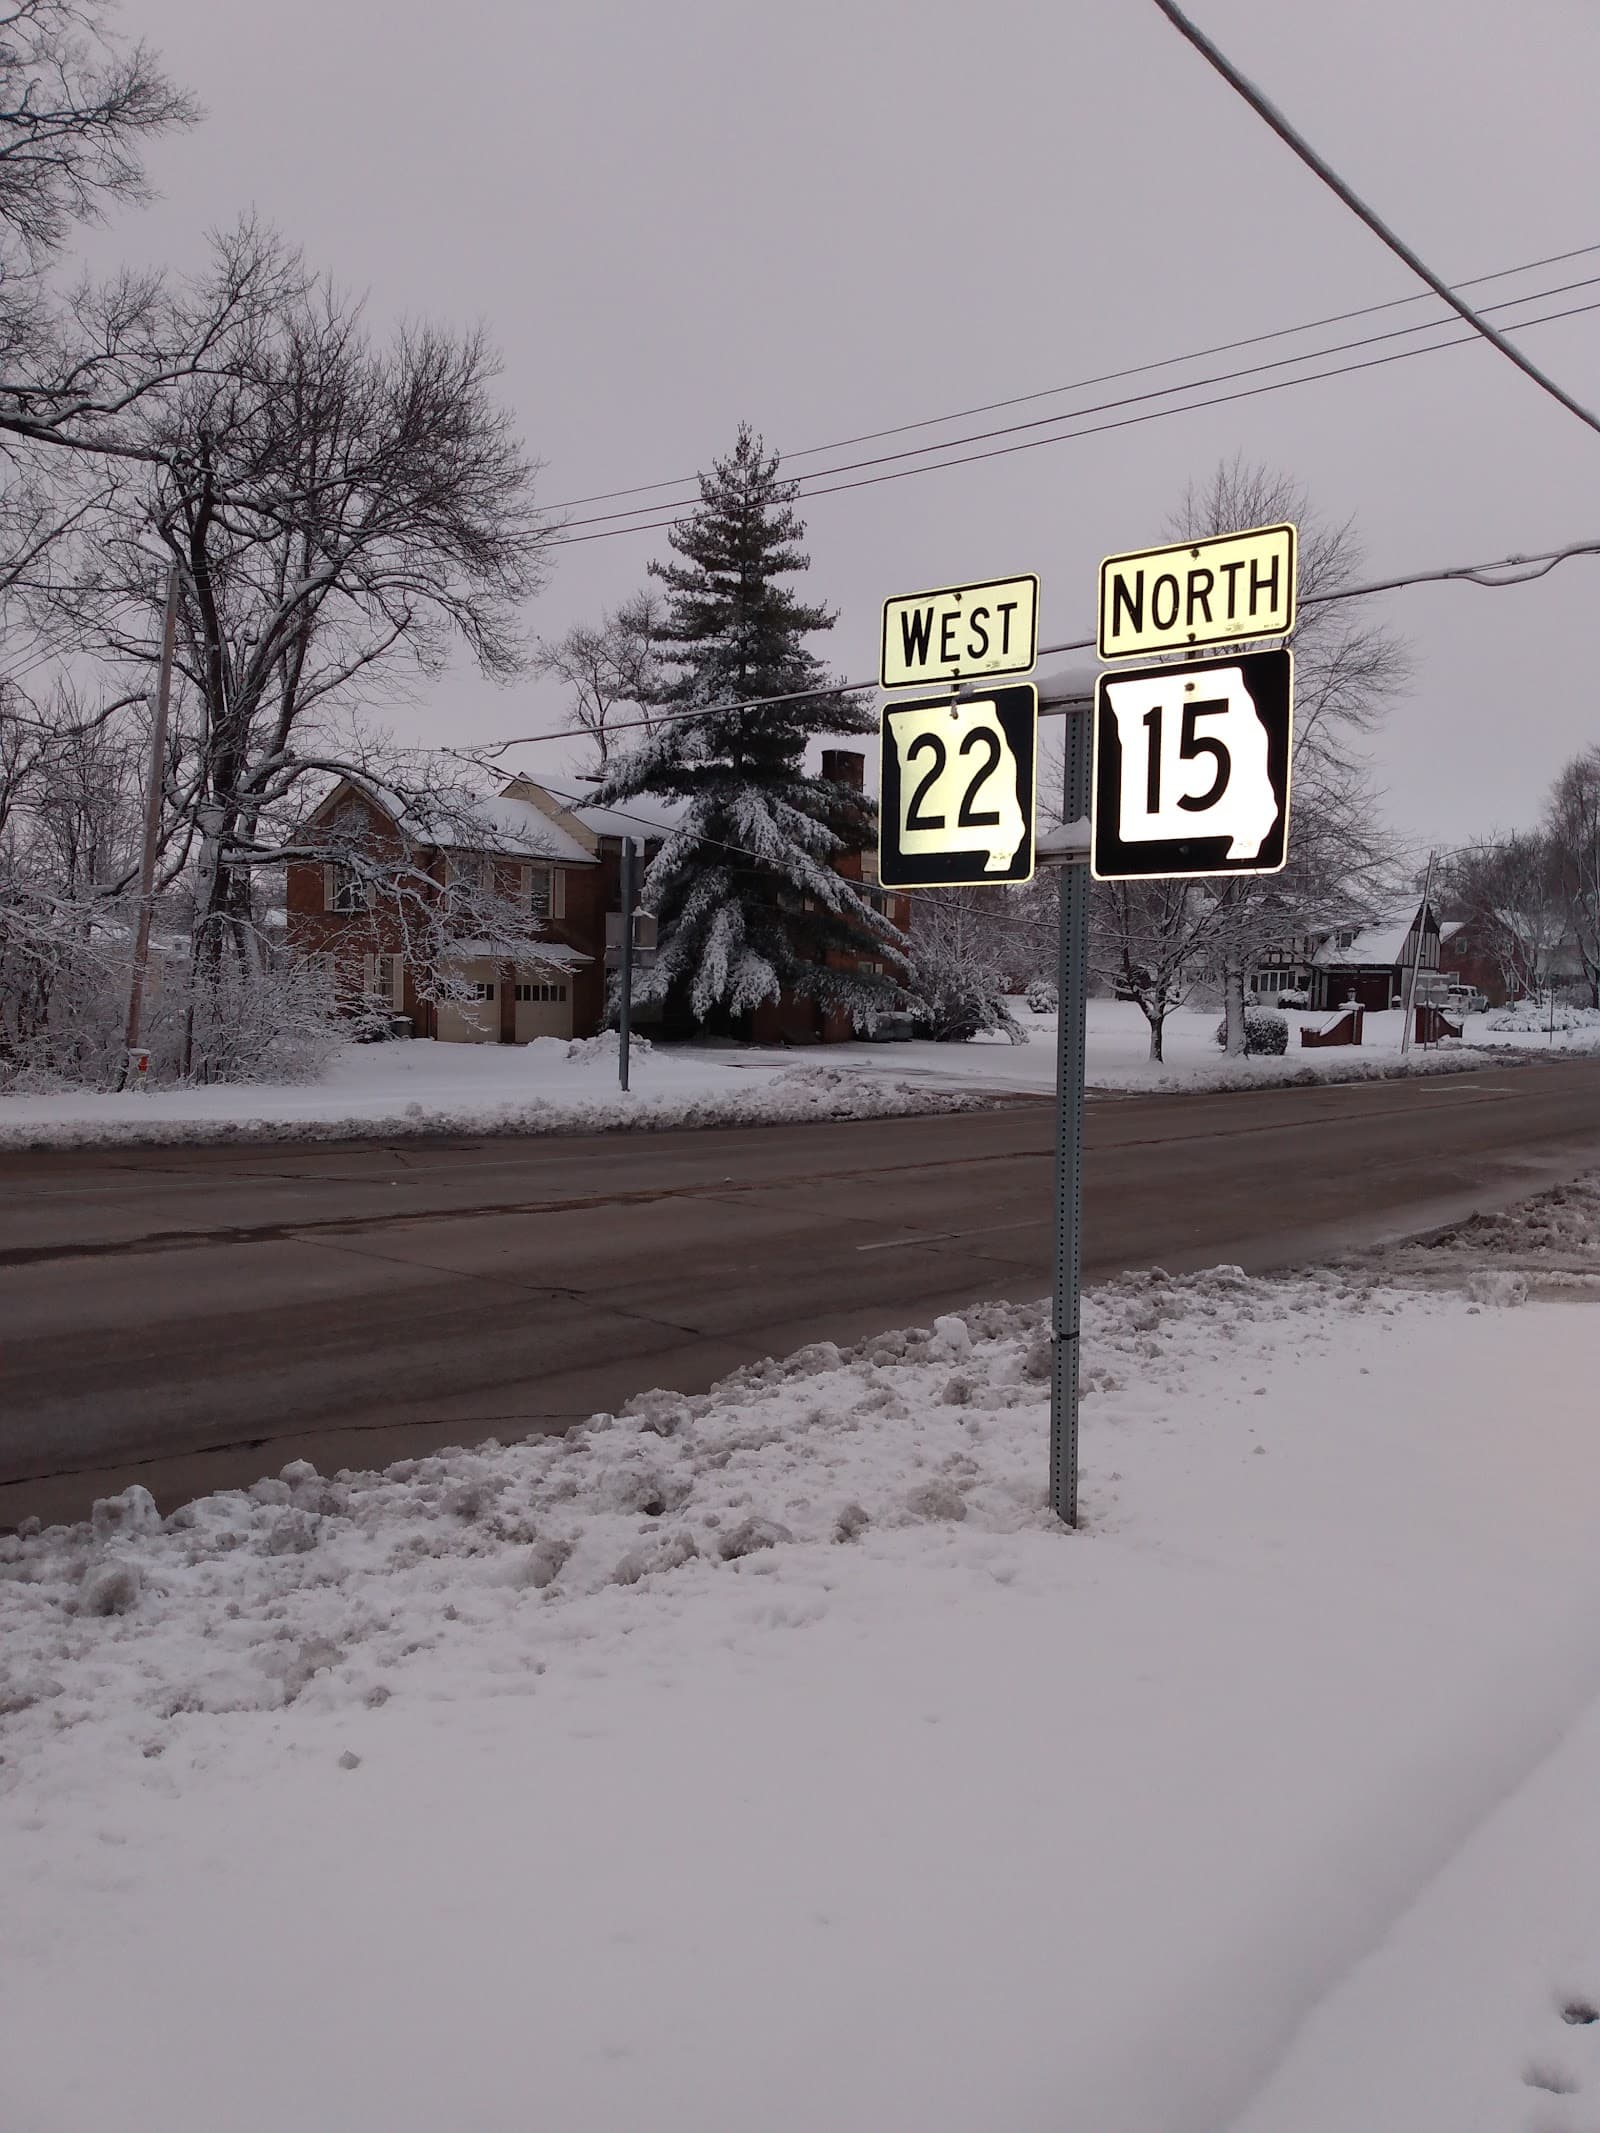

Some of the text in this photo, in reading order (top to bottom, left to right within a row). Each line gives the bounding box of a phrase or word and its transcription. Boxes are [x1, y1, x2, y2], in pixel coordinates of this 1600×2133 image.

[901, 602, 1018, 667] WEST
[1112, 555, 1280, 638] NORTH
[905, 726, 1001, 831] 22
[1143, 698, 1231, 814] 15
